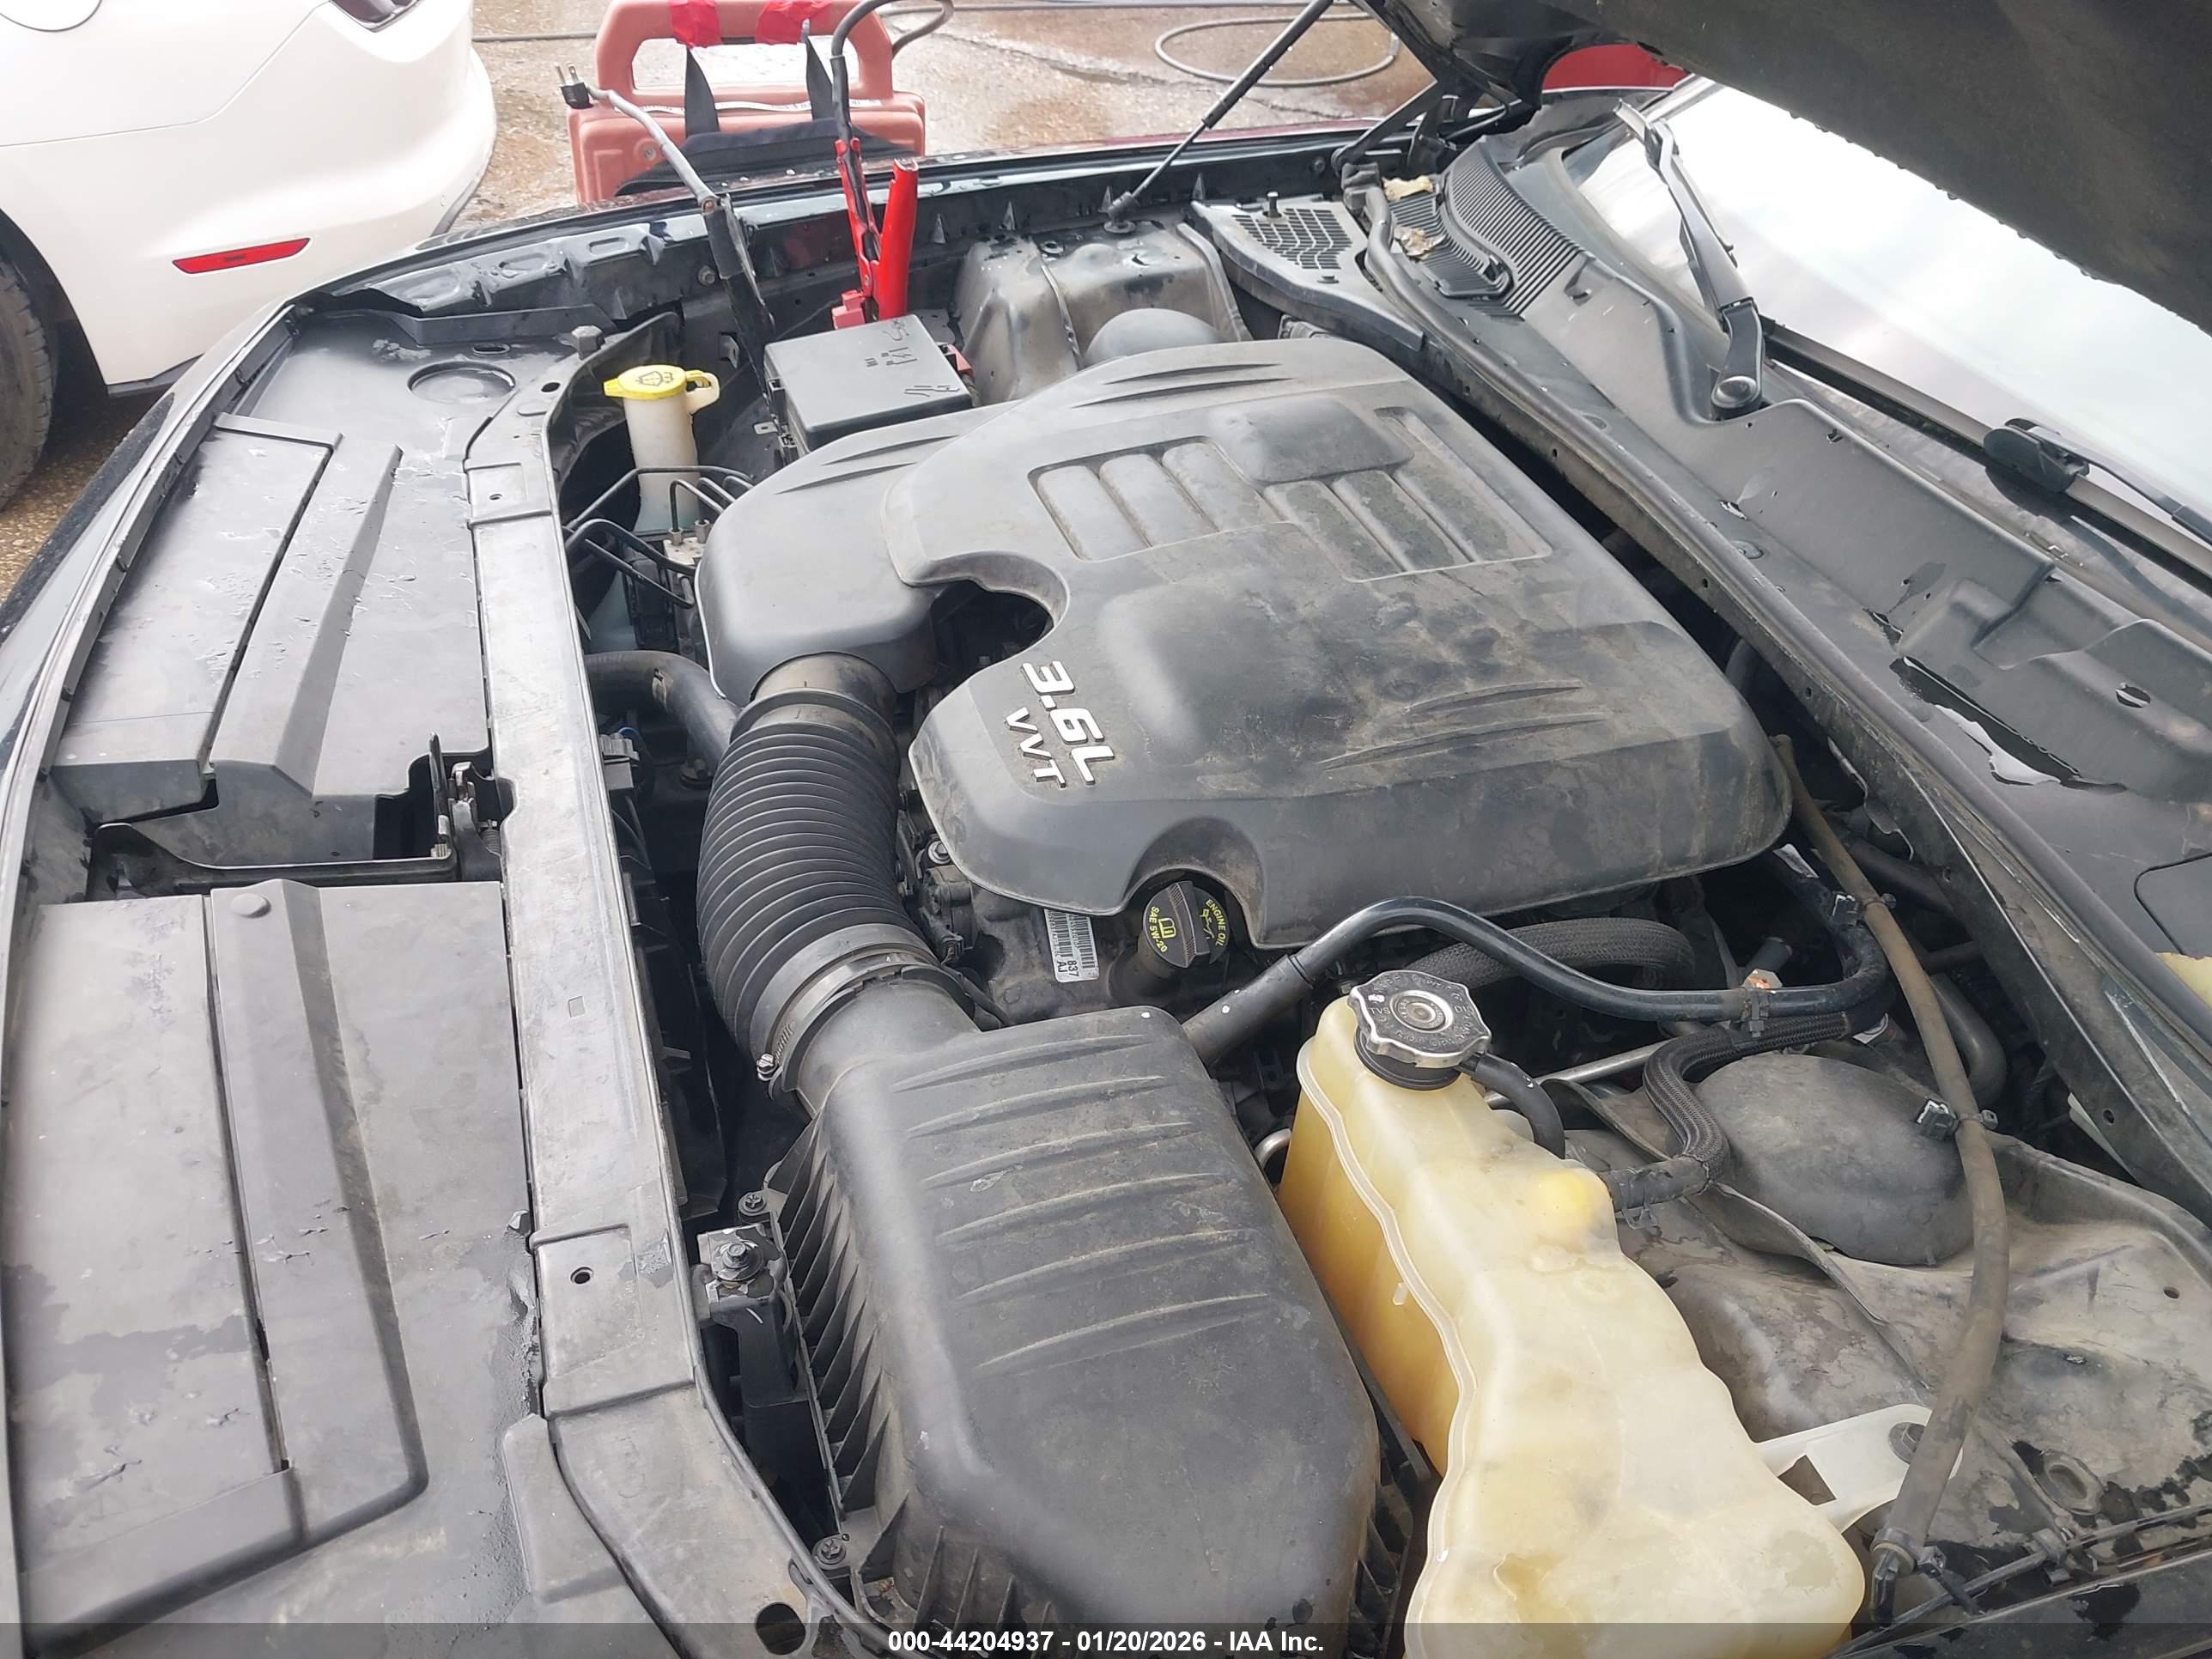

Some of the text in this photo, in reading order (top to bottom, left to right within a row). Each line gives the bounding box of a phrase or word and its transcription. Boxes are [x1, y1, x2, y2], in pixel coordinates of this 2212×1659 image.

[1021, 660, 1115, 785] 3.6L
[1006, 707, 1066, 788] VVT
[1149, 906, 1168, 953] SAE 5W-20
[1206, 898, 1226, 946] ENGINE OIL
[1056, 961, 1067, 974] AJ
[1067, 960, 1079, 977] 837
